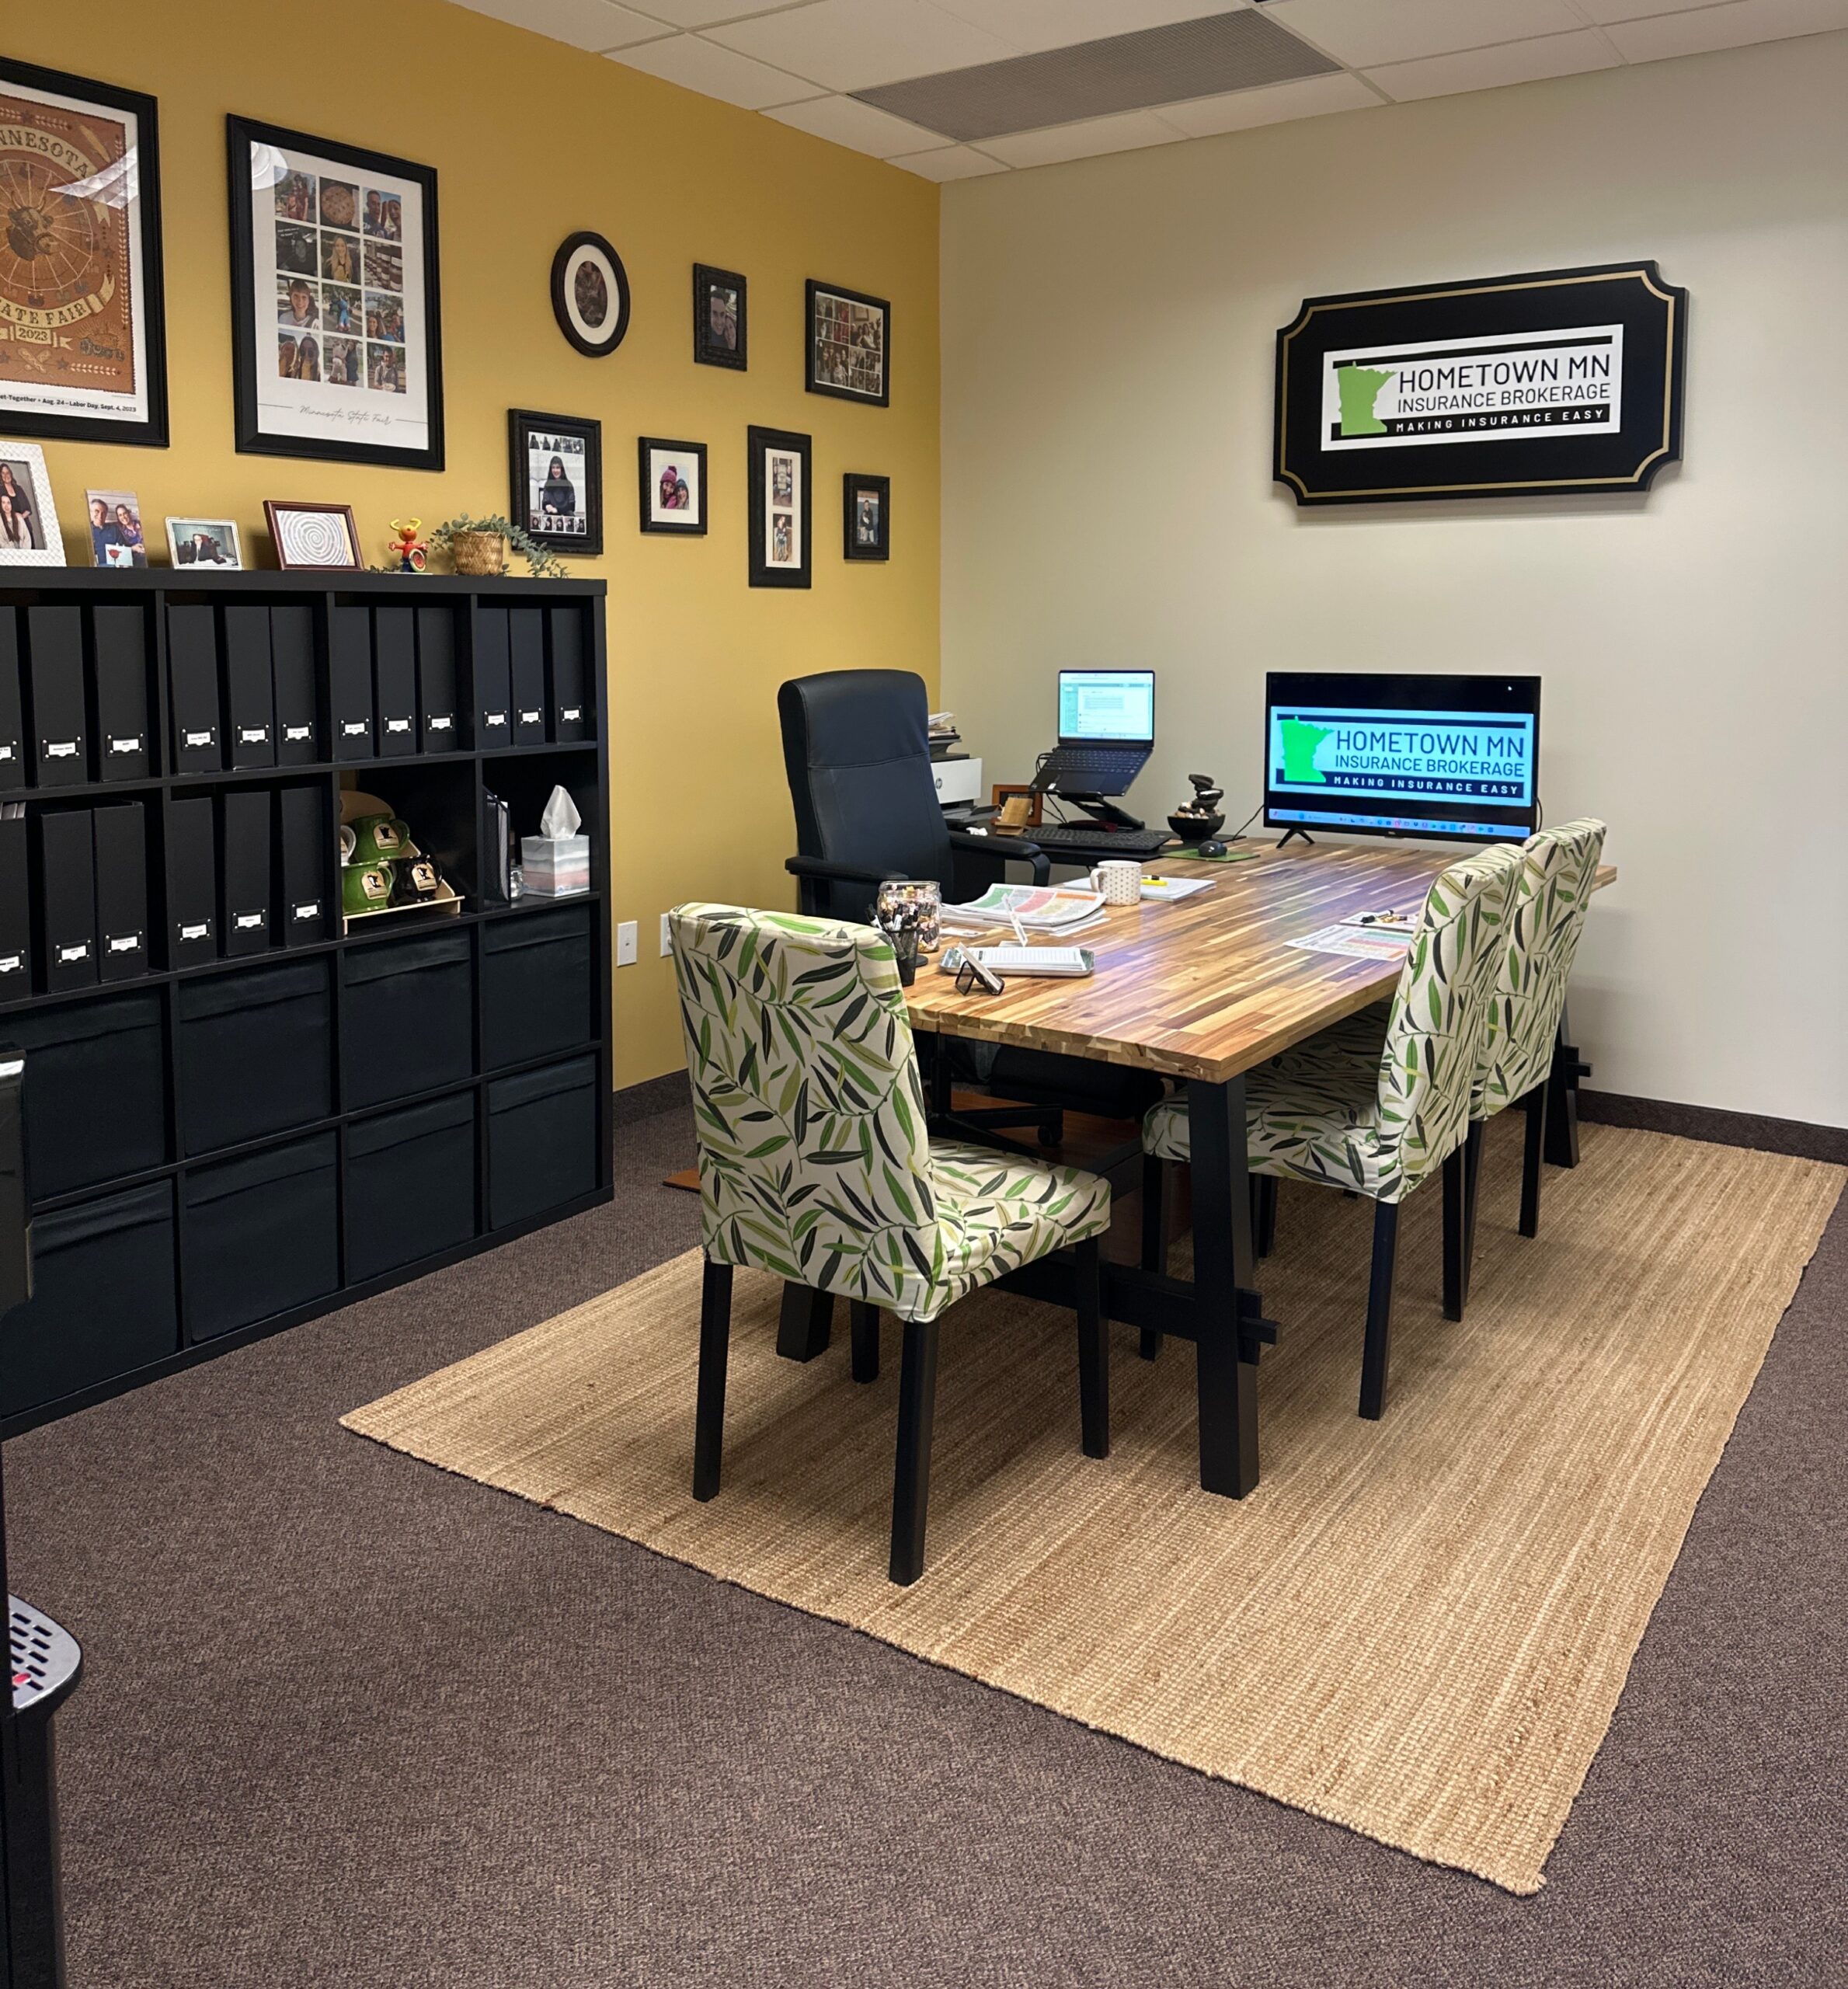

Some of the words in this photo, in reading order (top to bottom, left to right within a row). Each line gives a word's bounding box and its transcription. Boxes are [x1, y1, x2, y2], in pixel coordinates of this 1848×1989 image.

[45, 302, 86, 325] FAIR
[18, 327, 48, 341] 2023
[1399, 357, 1558, 394] HOMETOWN
[1568, 354, 1610, 380] MN
[1397, 392, 1496, 413] INSURANCE
[1501, 382, 1611, 406] BROKERAGE
[1396, 420, 1453, 433] MAKING
[1461, 412, 1552, 428] INSURANCE
[1562, 409, 1604, 421] EASY
[1336, 730, 1478, 756] HOMETOWN
[1487, 735, 1525, 758] MN
[1335, 754, 1422, 772] INSURANCE
[1426, 759, 1525, 778] BROKERAGE
[1334, 776, 1385, 788] MAKING
[1391, 780, 1473, 793] INSURANCE
[1481, 785, 1519, 796] EASY
